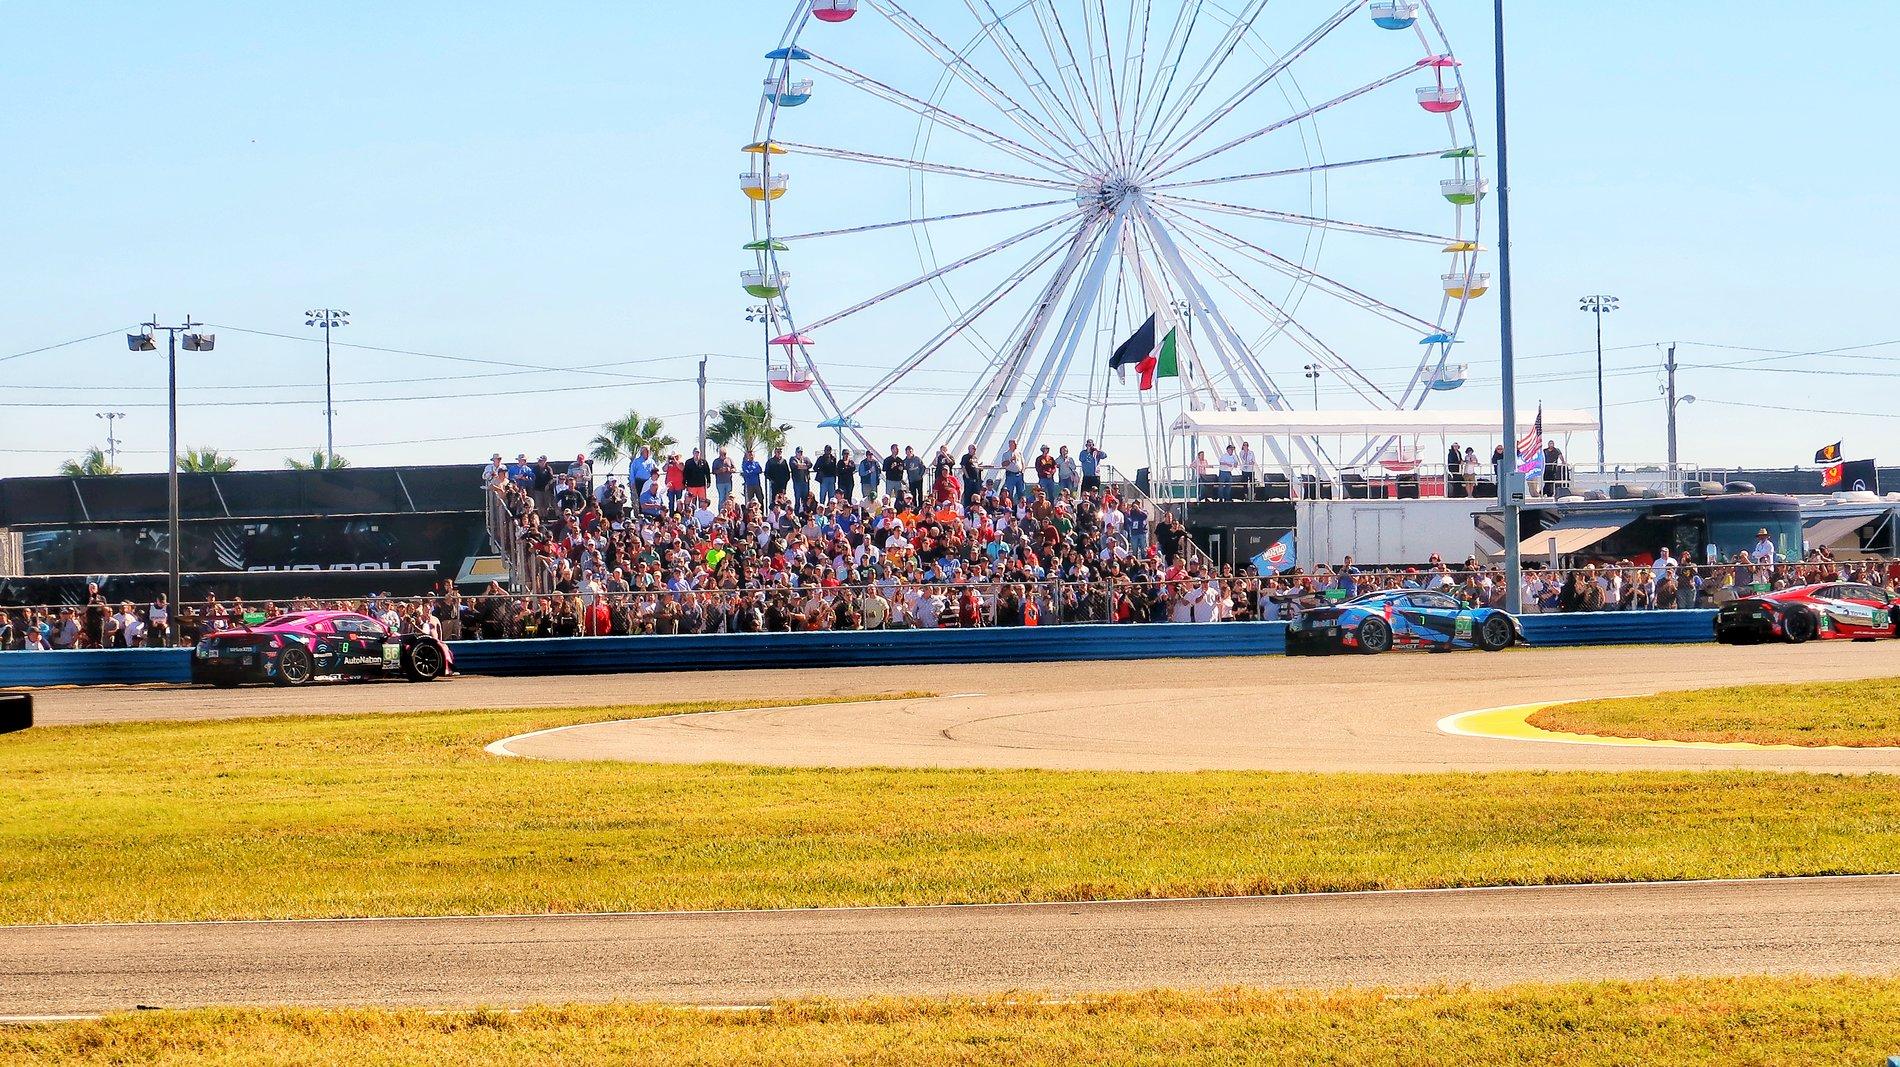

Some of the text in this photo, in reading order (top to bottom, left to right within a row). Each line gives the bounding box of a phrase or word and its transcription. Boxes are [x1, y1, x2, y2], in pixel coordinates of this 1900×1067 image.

[1874, 612, 1886, 623] 48
[1456, 619, 1470, 630] 57
[342, 642, 349, 653] 8
[385, 647, 398, 660] 86
[344, 656, 382, 664] AutoNation
